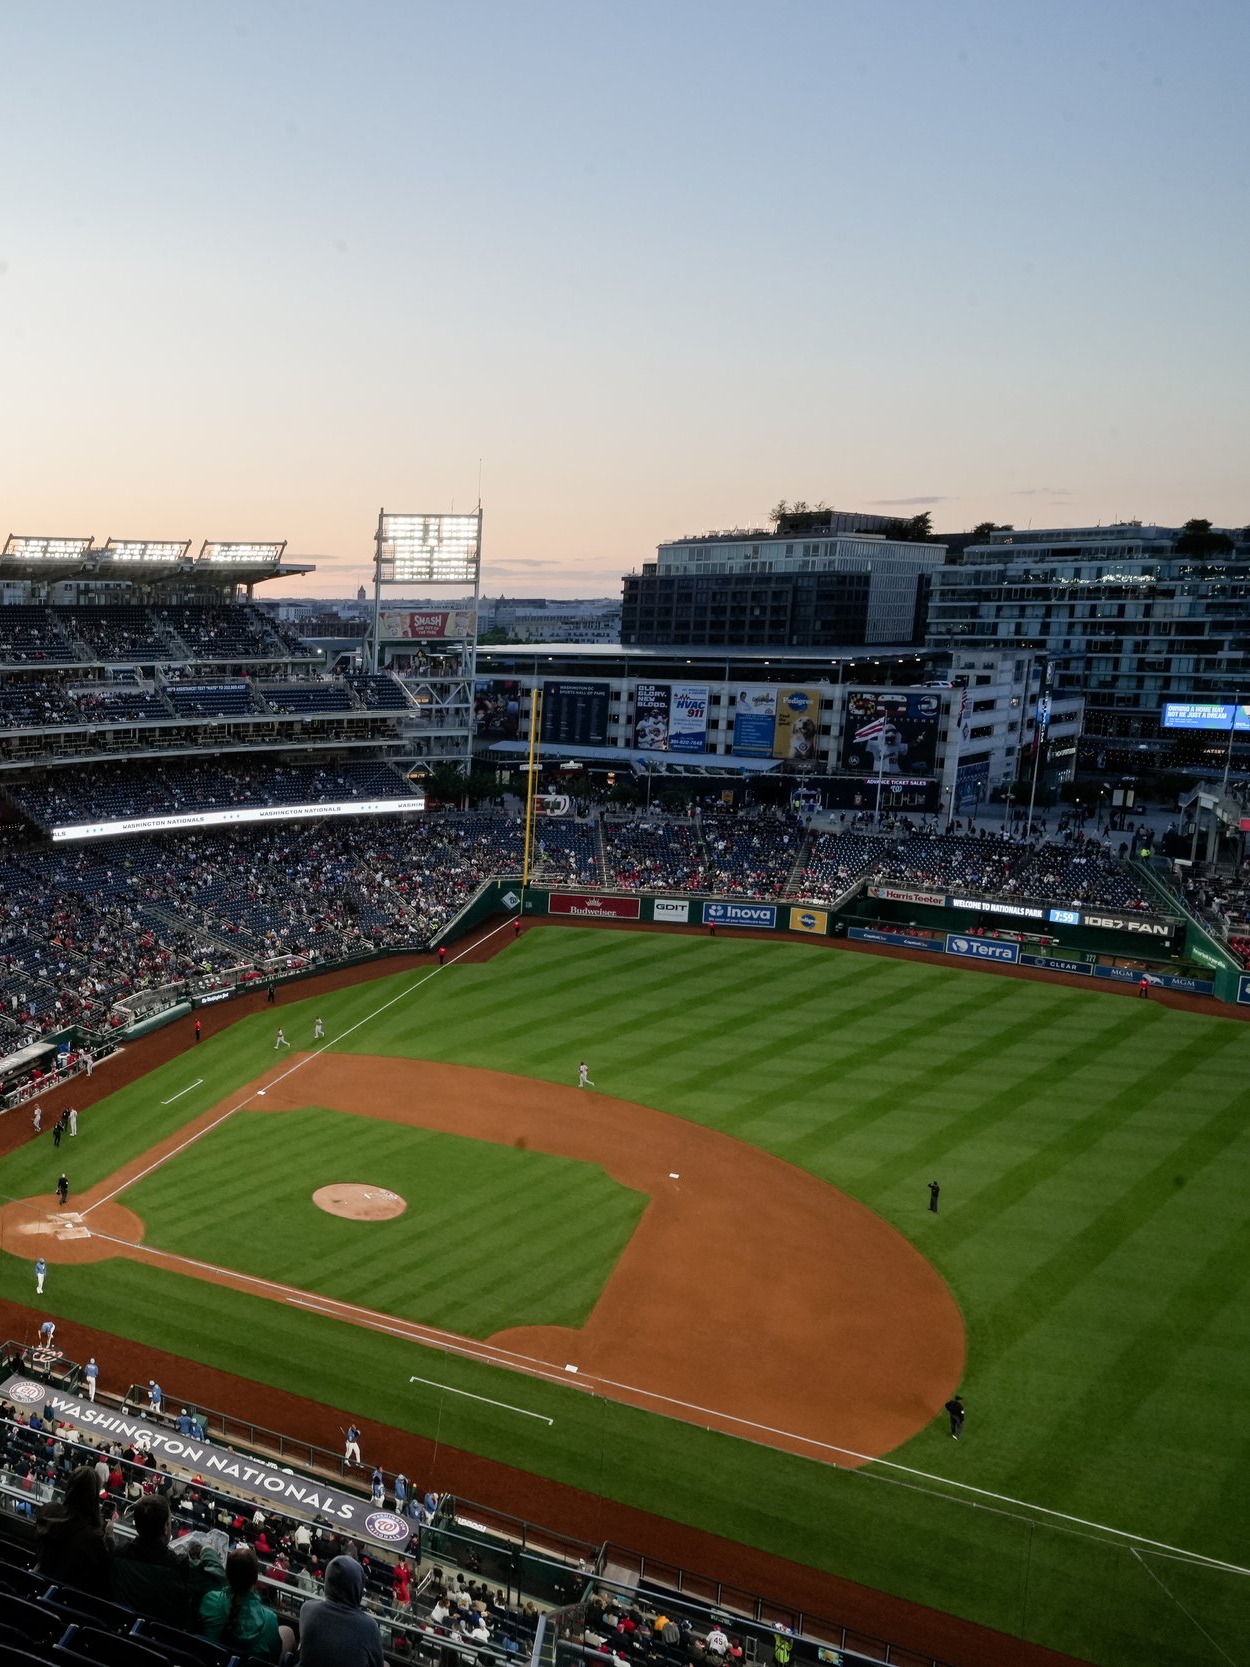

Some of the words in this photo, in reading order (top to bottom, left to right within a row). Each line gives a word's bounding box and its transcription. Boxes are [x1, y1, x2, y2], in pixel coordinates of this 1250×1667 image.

[414, 614, 442, 626] SMASH
[676, 701, 706, 709] HVAC
[782, 697, 814, 705] Pedigree
[687, 709, 704, 718] 911
[850, 714, 934, 723] STEAFITTERS
[122, 820, 165, 829] WASHINGTON
[887, 890, 913, 901] Harris
[914, 895, 943, 904] Teeter
[570, 906, 617, 916] Budweiser
[656, 904, 687, 912] GDIT
[953, 899, 981, 910] WELCOME
[982, 903, 990, 911] TO
[990, 904, 1024, 915] NATIONALS
[1025, 908, 1043, 918] PARK
[727, 906, 770, 920] Inova
[1055, 912, 1074, 922] 7:59
[1128, 922, 1168, 935] FAN
[970, 942, 1012, 958] Terra
[1085, 954, 1097, 963] 377
[1050, 961, 1077, 970] CLEAR
[1111, 969, 1133, 978] MGM
[1172, 978, 1195, 986] MGM
[52, 1397, 204, 1462] WASHINGTON
[206, 1455, 355, 1519] NATIONALS
[372, 1514, 406, 1530] WASHINGTON
[369, 1525, 400, 1539] NATIONALS
[713, 1637, 723, 1646] 45
